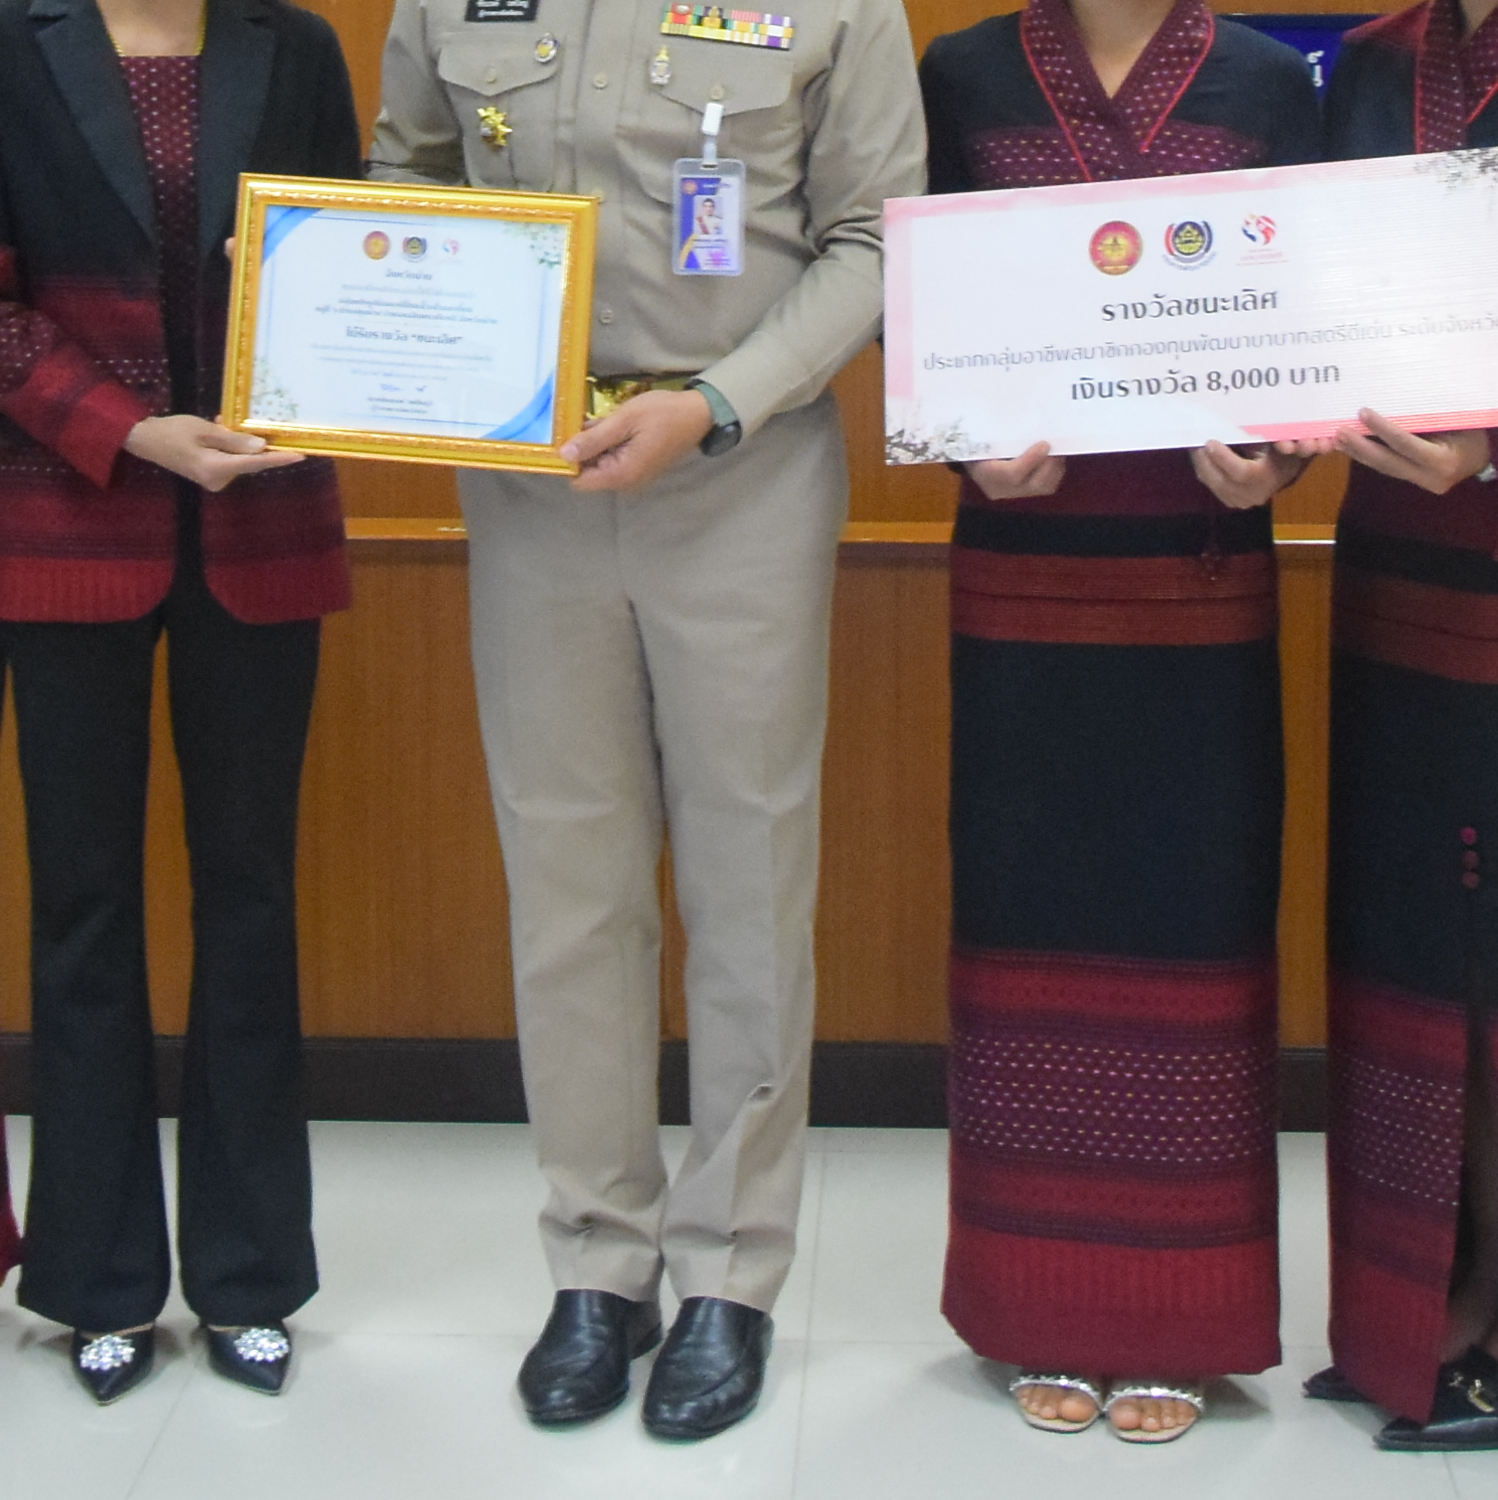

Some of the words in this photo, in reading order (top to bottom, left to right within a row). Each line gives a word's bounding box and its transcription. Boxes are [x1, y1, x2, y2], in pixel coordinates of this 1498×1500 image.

[1101, 288, 1278, 322] รางวัลชนะเลิศ
[1071, 369, 1197, 400] เงินรางวัล
[1206, 367, 1280, 395] 8,000
[1289, 364, 1340, 386] บาท
